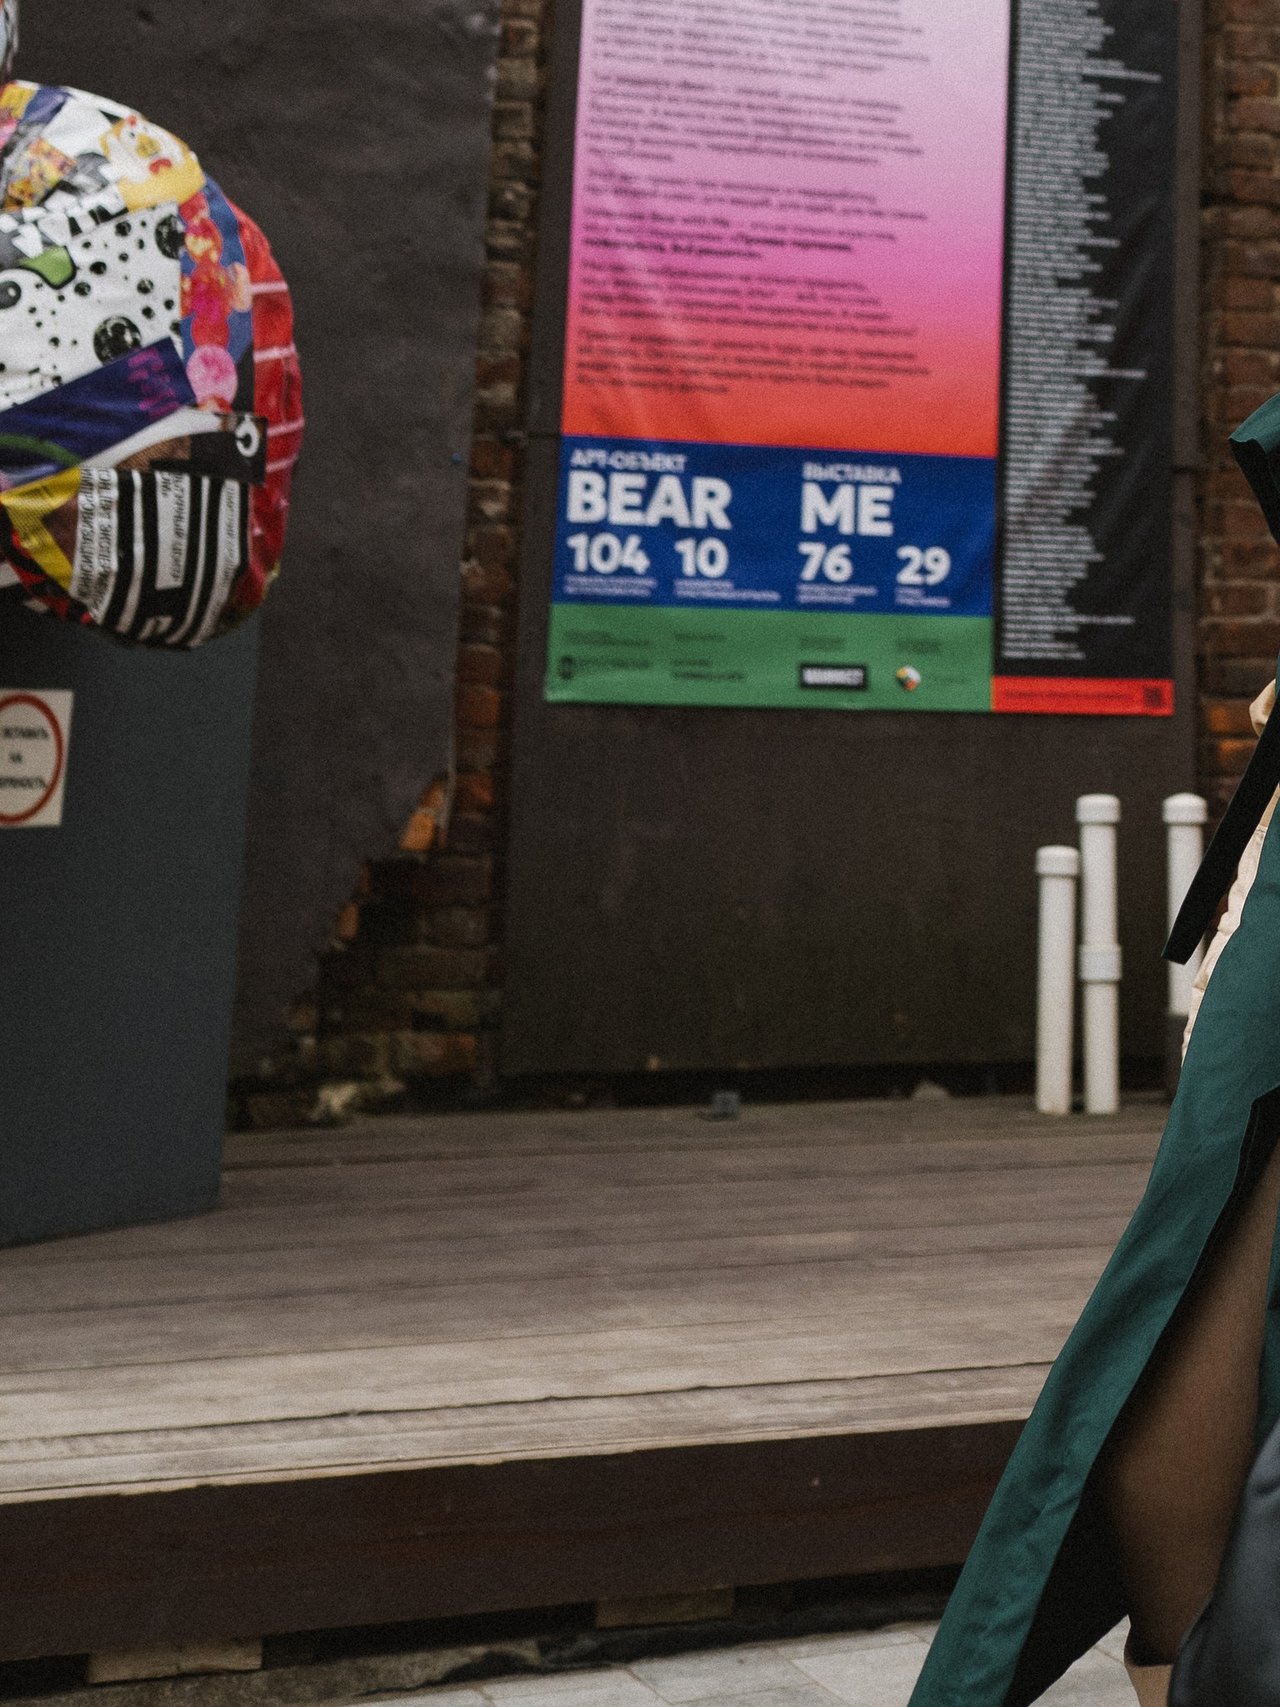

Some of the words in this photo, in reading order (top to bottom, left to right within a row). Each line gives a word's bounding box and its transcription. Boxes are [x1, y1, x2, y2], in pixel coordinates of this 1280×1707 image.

[570, 448, 687, 474] АРТ-ОБЪЕКТ
[803, 462, 902, 485] ВЫСТАВКА
[566, 471, 733, 531] BEAR
[801, 482, 895, 537] ME
[566, 533, 651, 576] 104
[674, 537, 729, 579] 10
[798, 542, 853, 583] 76
[896, 546, 952, 587] 29
